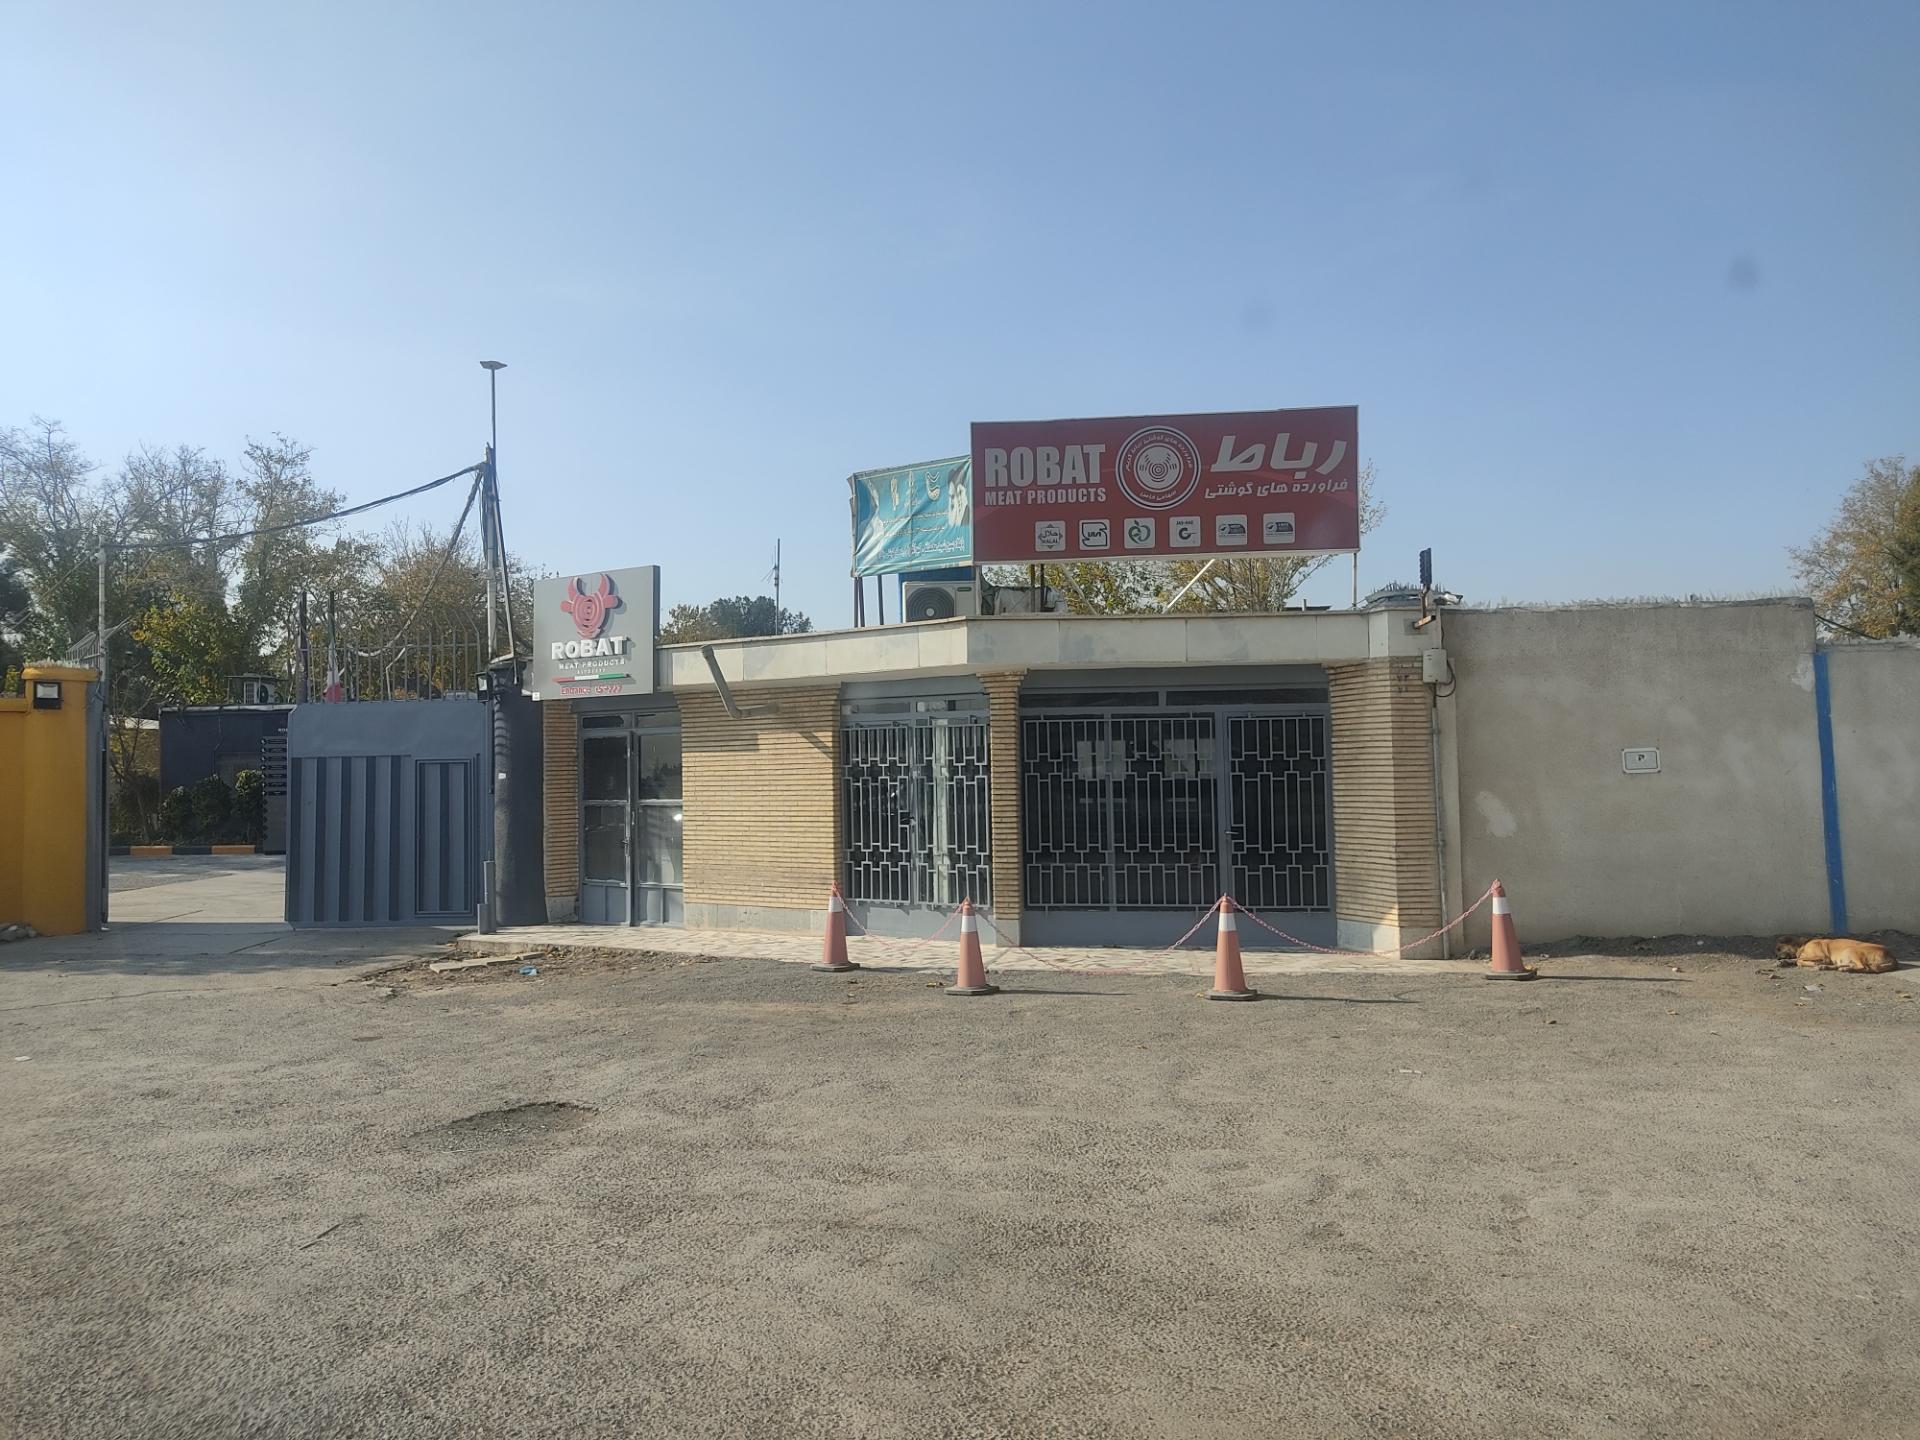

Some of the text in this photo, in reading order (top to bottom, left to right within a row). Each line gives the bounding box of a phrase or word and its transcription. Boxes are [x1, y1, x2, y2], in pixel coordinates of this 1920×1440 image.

[985, 444, 1106, 488] ROBAT
[1210, 432, 1347, 479] رباط
[985, 487, 1107, 506] MEAT PRODUCTS
[1204, 478, 1348, 498] فراورده های گوشتی
[552, 635, 625, 660] ROBAT
[558, 658, 625, 670] MEAT PRODUCTS
